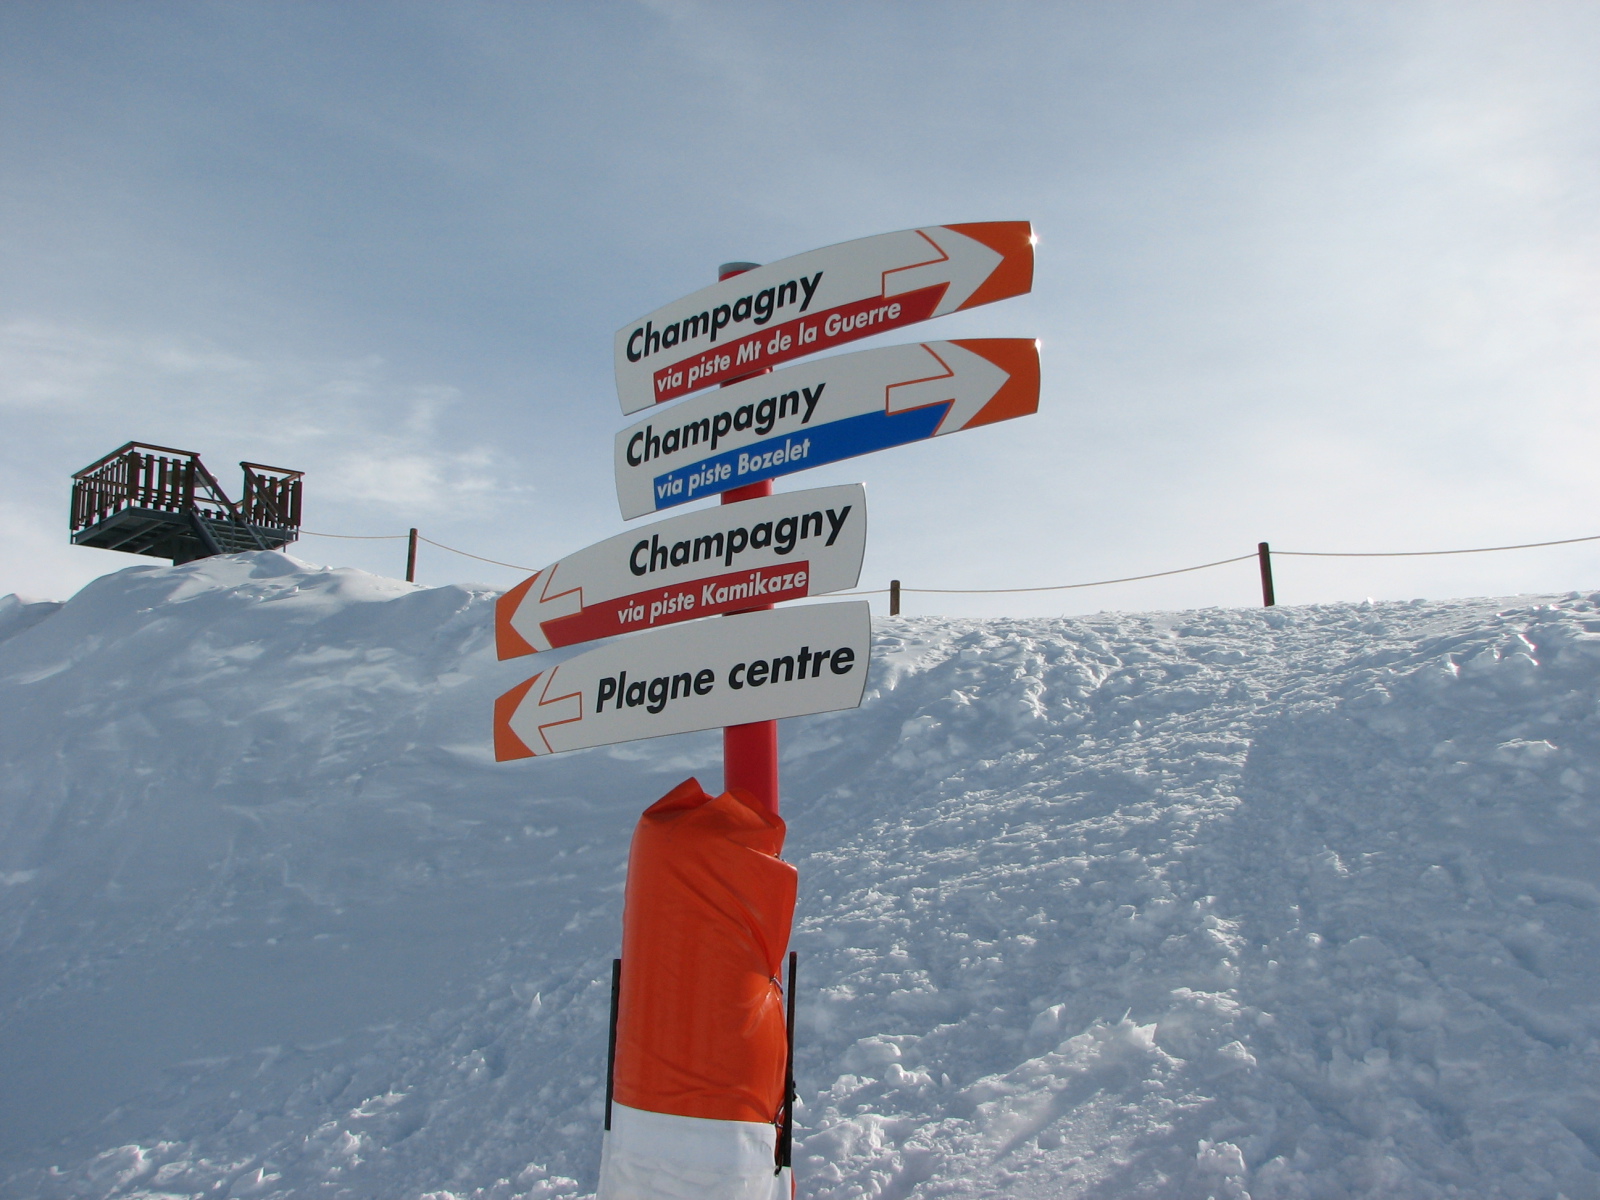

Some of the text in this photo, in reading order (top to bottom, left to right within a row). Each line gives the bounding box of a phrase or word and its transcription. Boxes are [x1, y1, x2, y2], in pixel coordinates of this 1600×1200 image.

[626, 271, 824, 363] Champagny
[656, 302, 902, 393] via piste Mt de la Guerre
[626, 382, 826, 467] Champagny
[657, 439, 811, 499] via piste Bozelet
[629, 505, 853, 577] Champagny
[617, 569, 808, 624] via piste Kamikaze
[596, 646, 856, 714] Plagne centre
